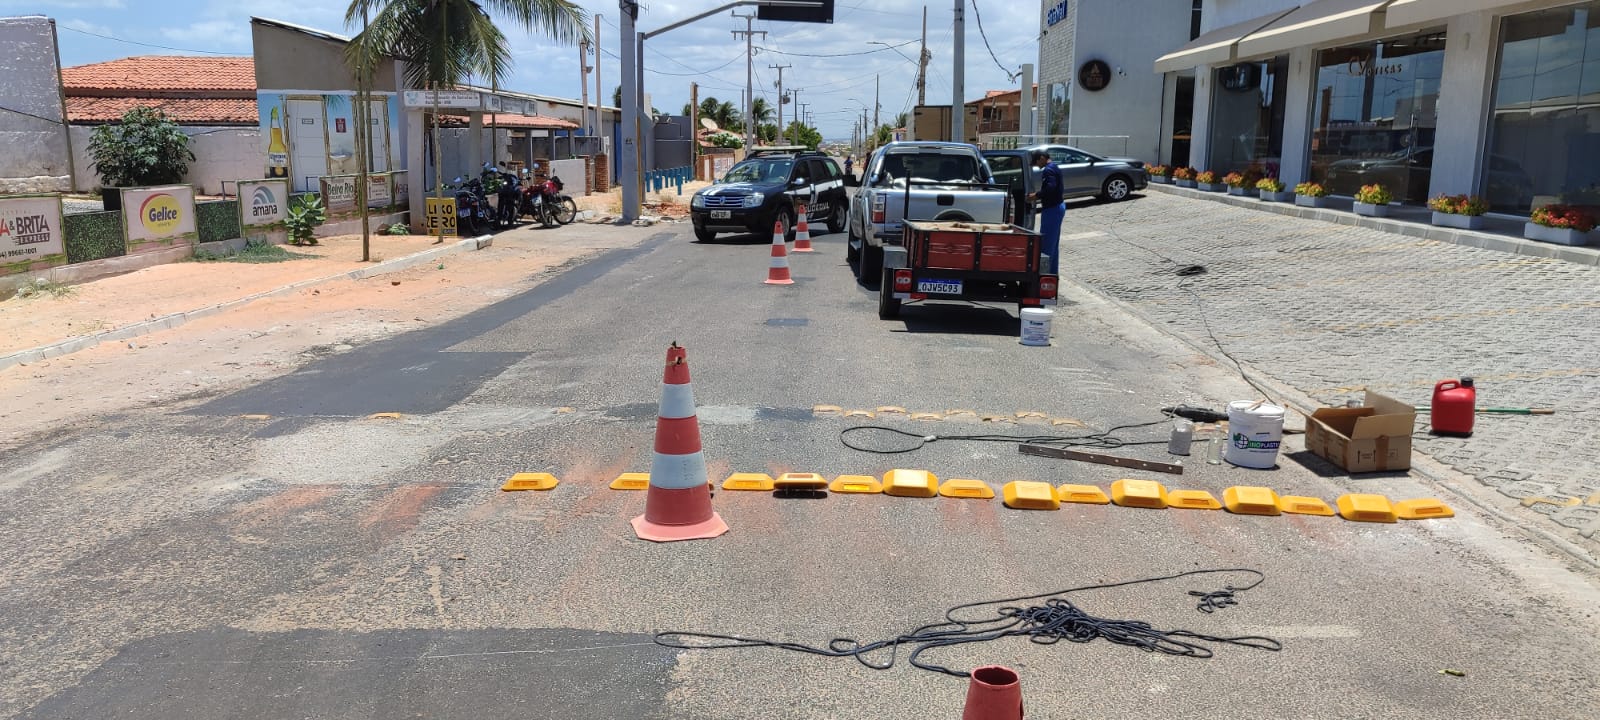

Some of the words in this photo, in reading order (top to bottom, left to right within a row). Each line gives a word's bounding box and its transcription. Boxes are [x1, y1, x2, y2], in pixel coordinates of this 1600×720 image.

[149, 206, 177, 222] Gelice
[252, 205, 278, 217] amana
[15, 214, 50, 235] BRITA
